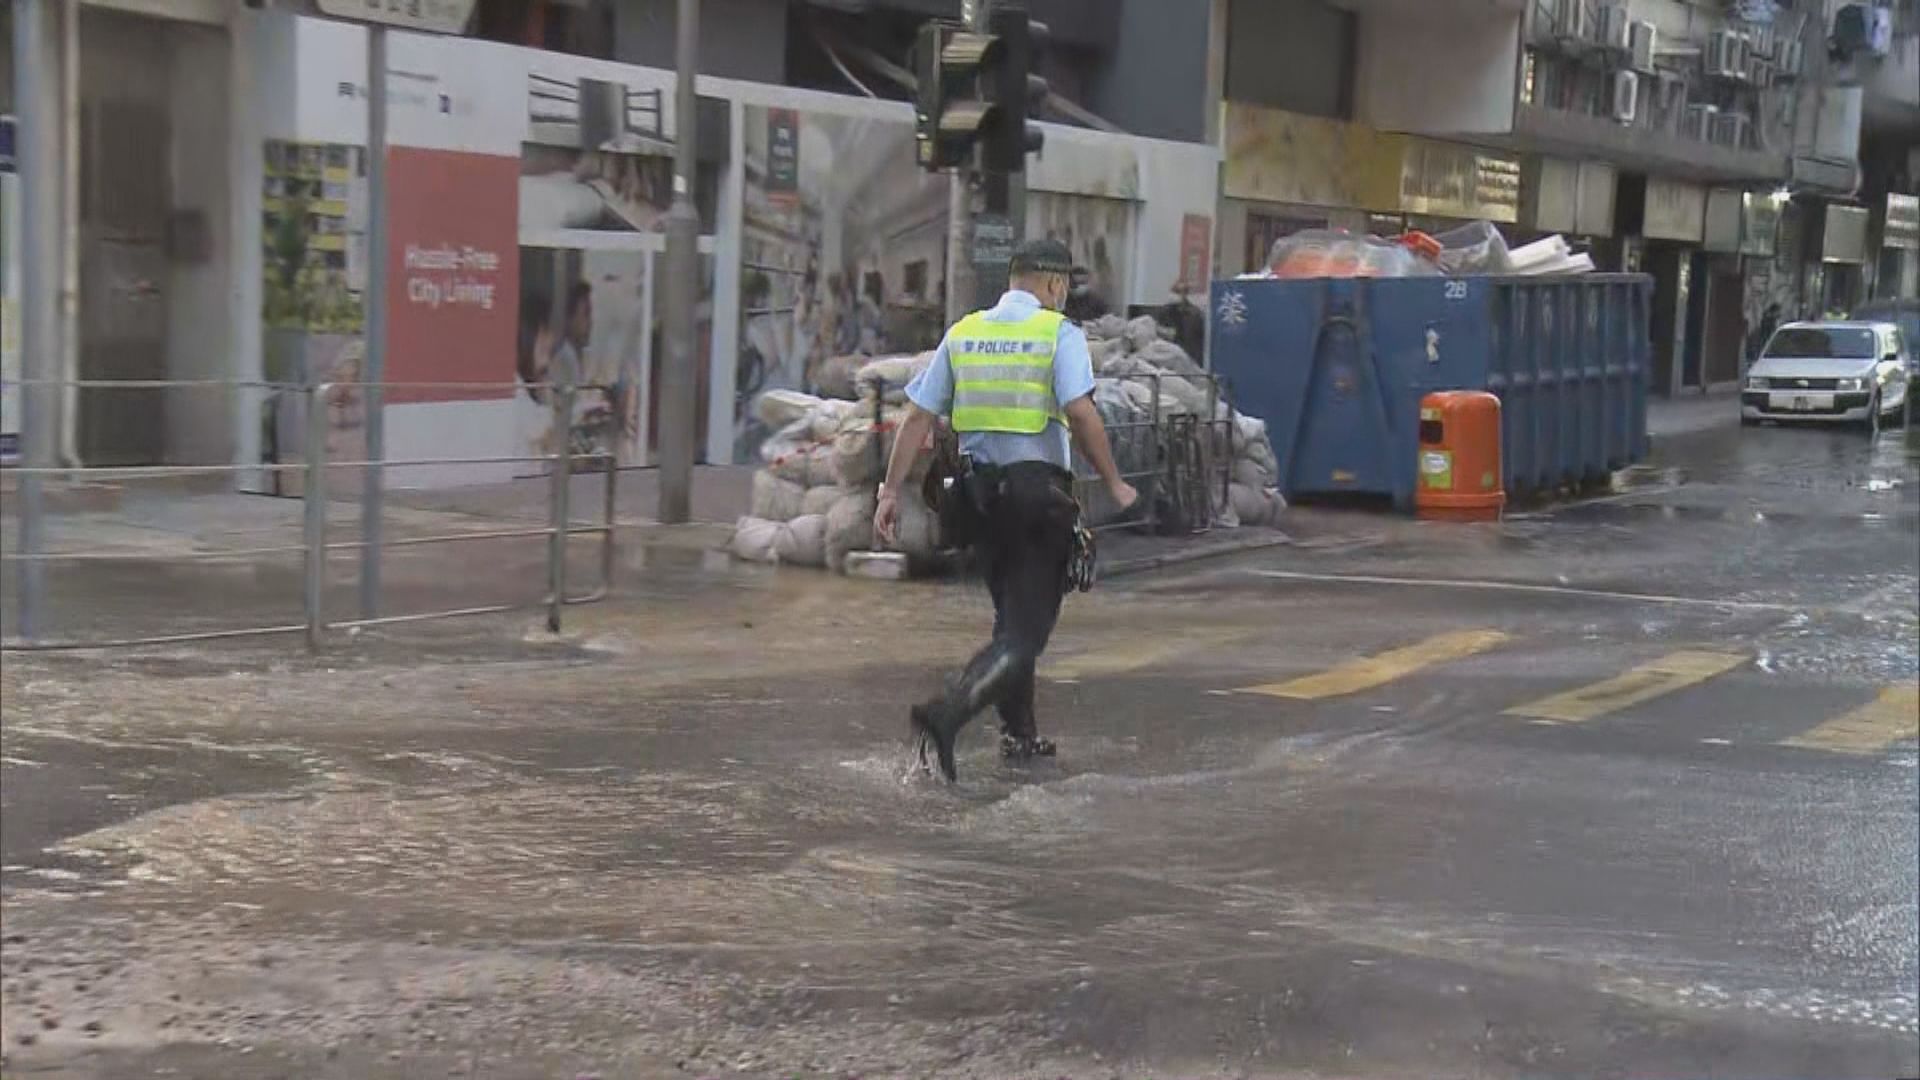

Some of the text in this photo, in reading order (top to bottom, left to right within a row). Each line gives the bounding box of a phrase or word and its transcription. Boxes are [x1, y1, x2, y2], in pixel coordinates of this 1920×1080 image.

[407, 278, 495, 310] City Living
[978, 340, 1019, 353] POLICE
